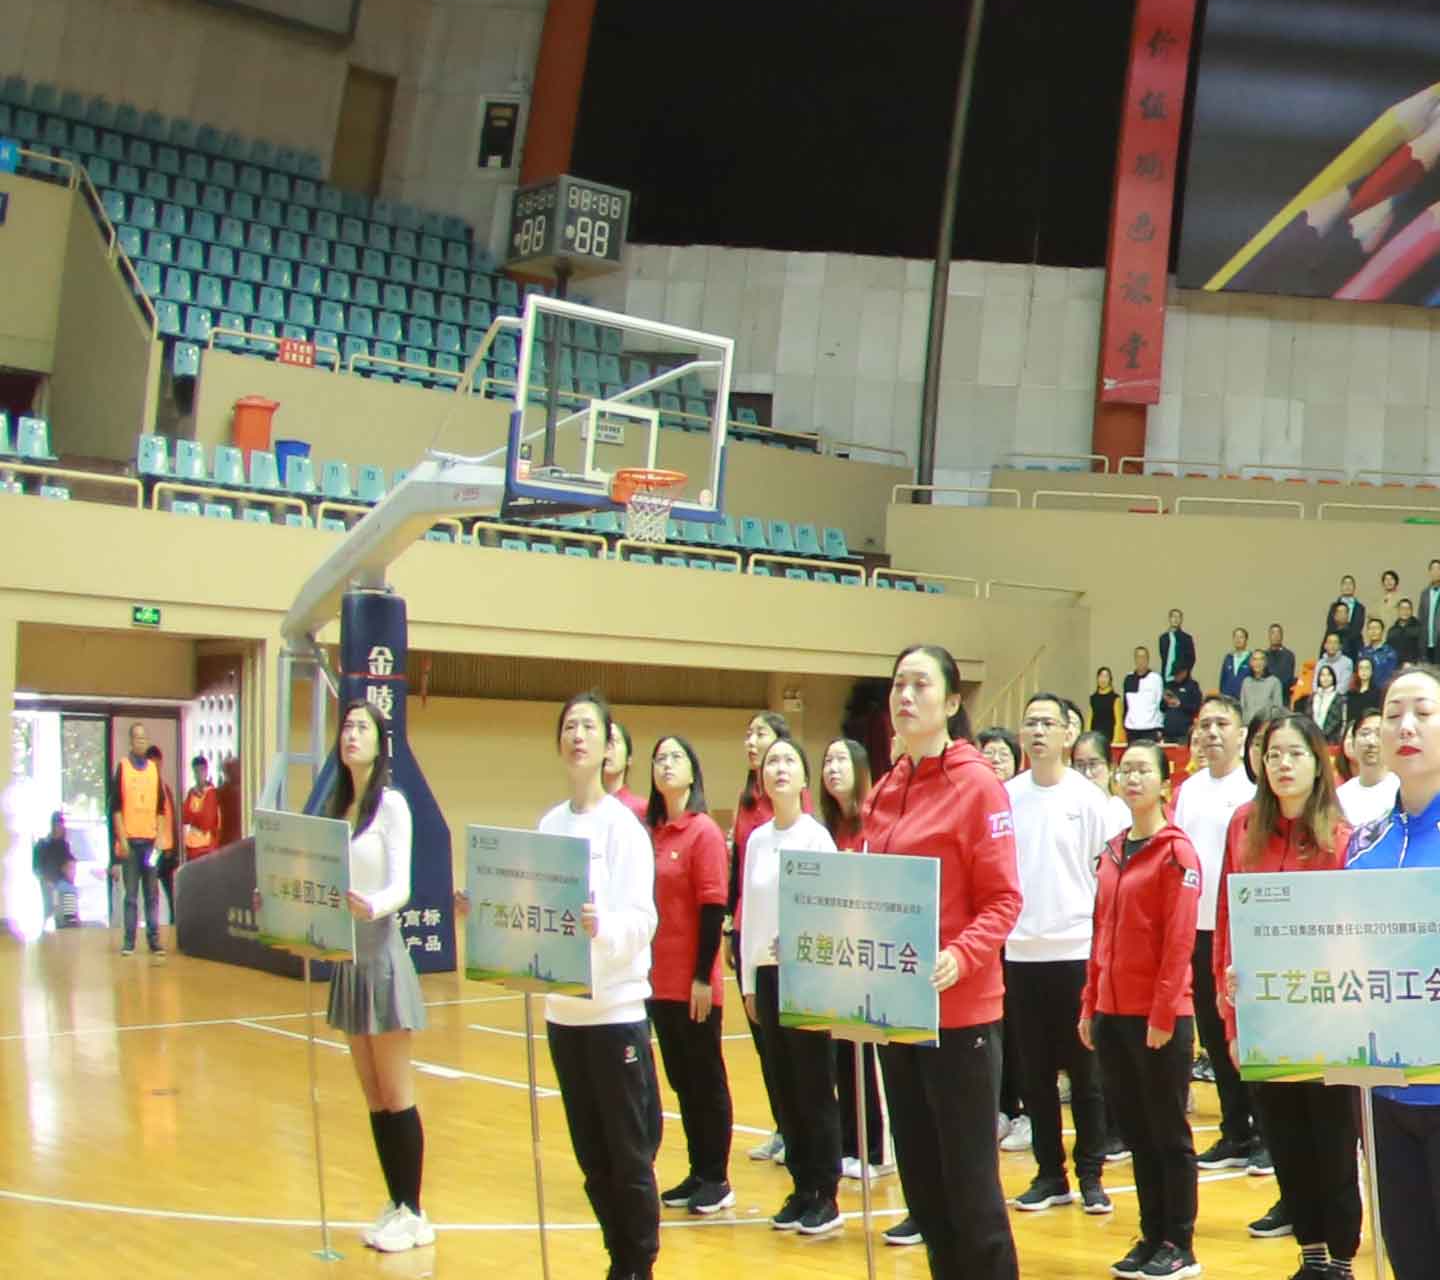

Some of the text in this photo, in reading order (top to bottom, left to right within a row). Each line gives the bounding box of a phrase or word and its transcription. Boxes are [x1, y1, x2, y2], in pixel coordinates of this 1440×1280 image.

[797, 930, 919, 976] 皮塑公司工会
